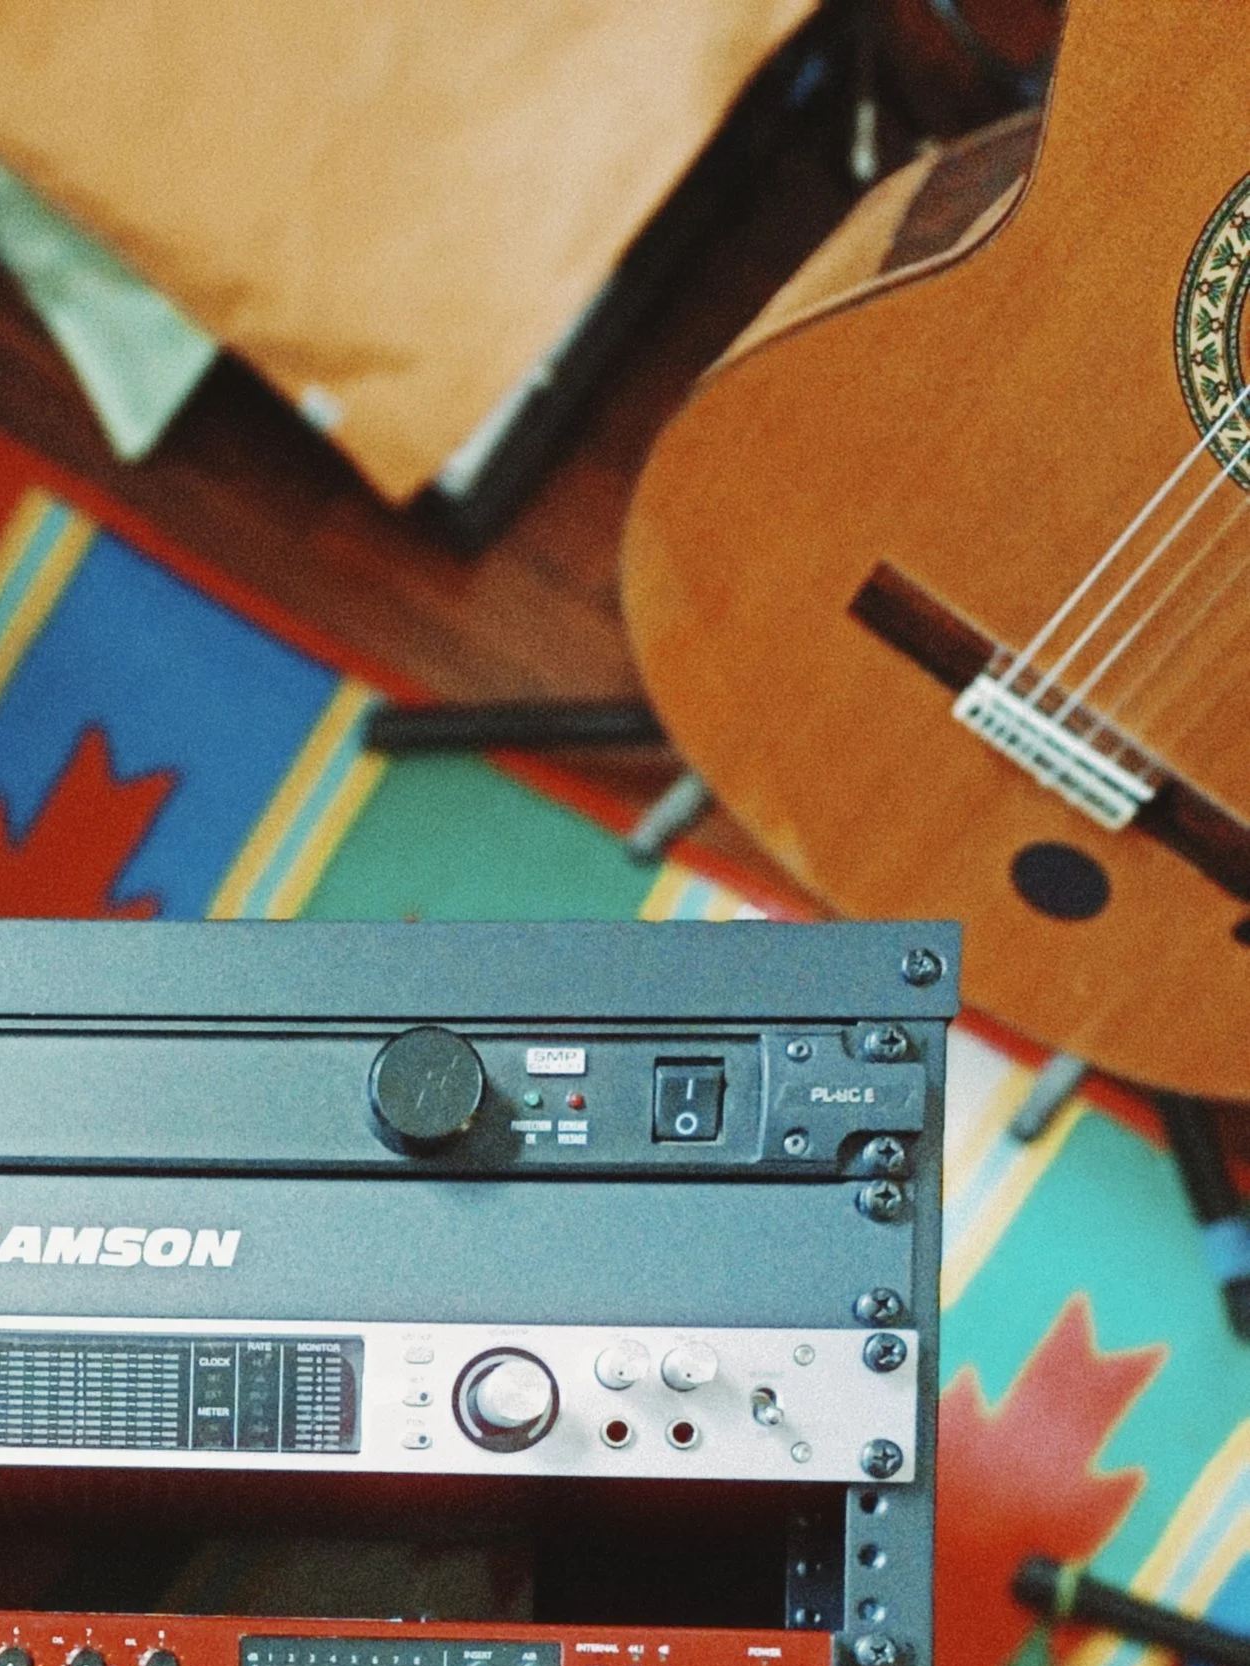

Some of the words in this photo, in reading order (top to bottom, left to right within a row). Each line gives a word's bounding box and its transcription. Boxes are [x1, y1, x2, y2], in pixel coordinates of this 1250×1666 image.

[534, 1051, 577, 1062] SMP
[248, 1342, 271, 1352] RATE
[297, 1343, 340, 1353] MONITOR
[199, 1358, 230, 1367] CLOCK
[198, 1407, 229, 1417] METER
[576, 1643, 619, 1653] INTERNAL
[748, 1647, 782, 1657] POWER
